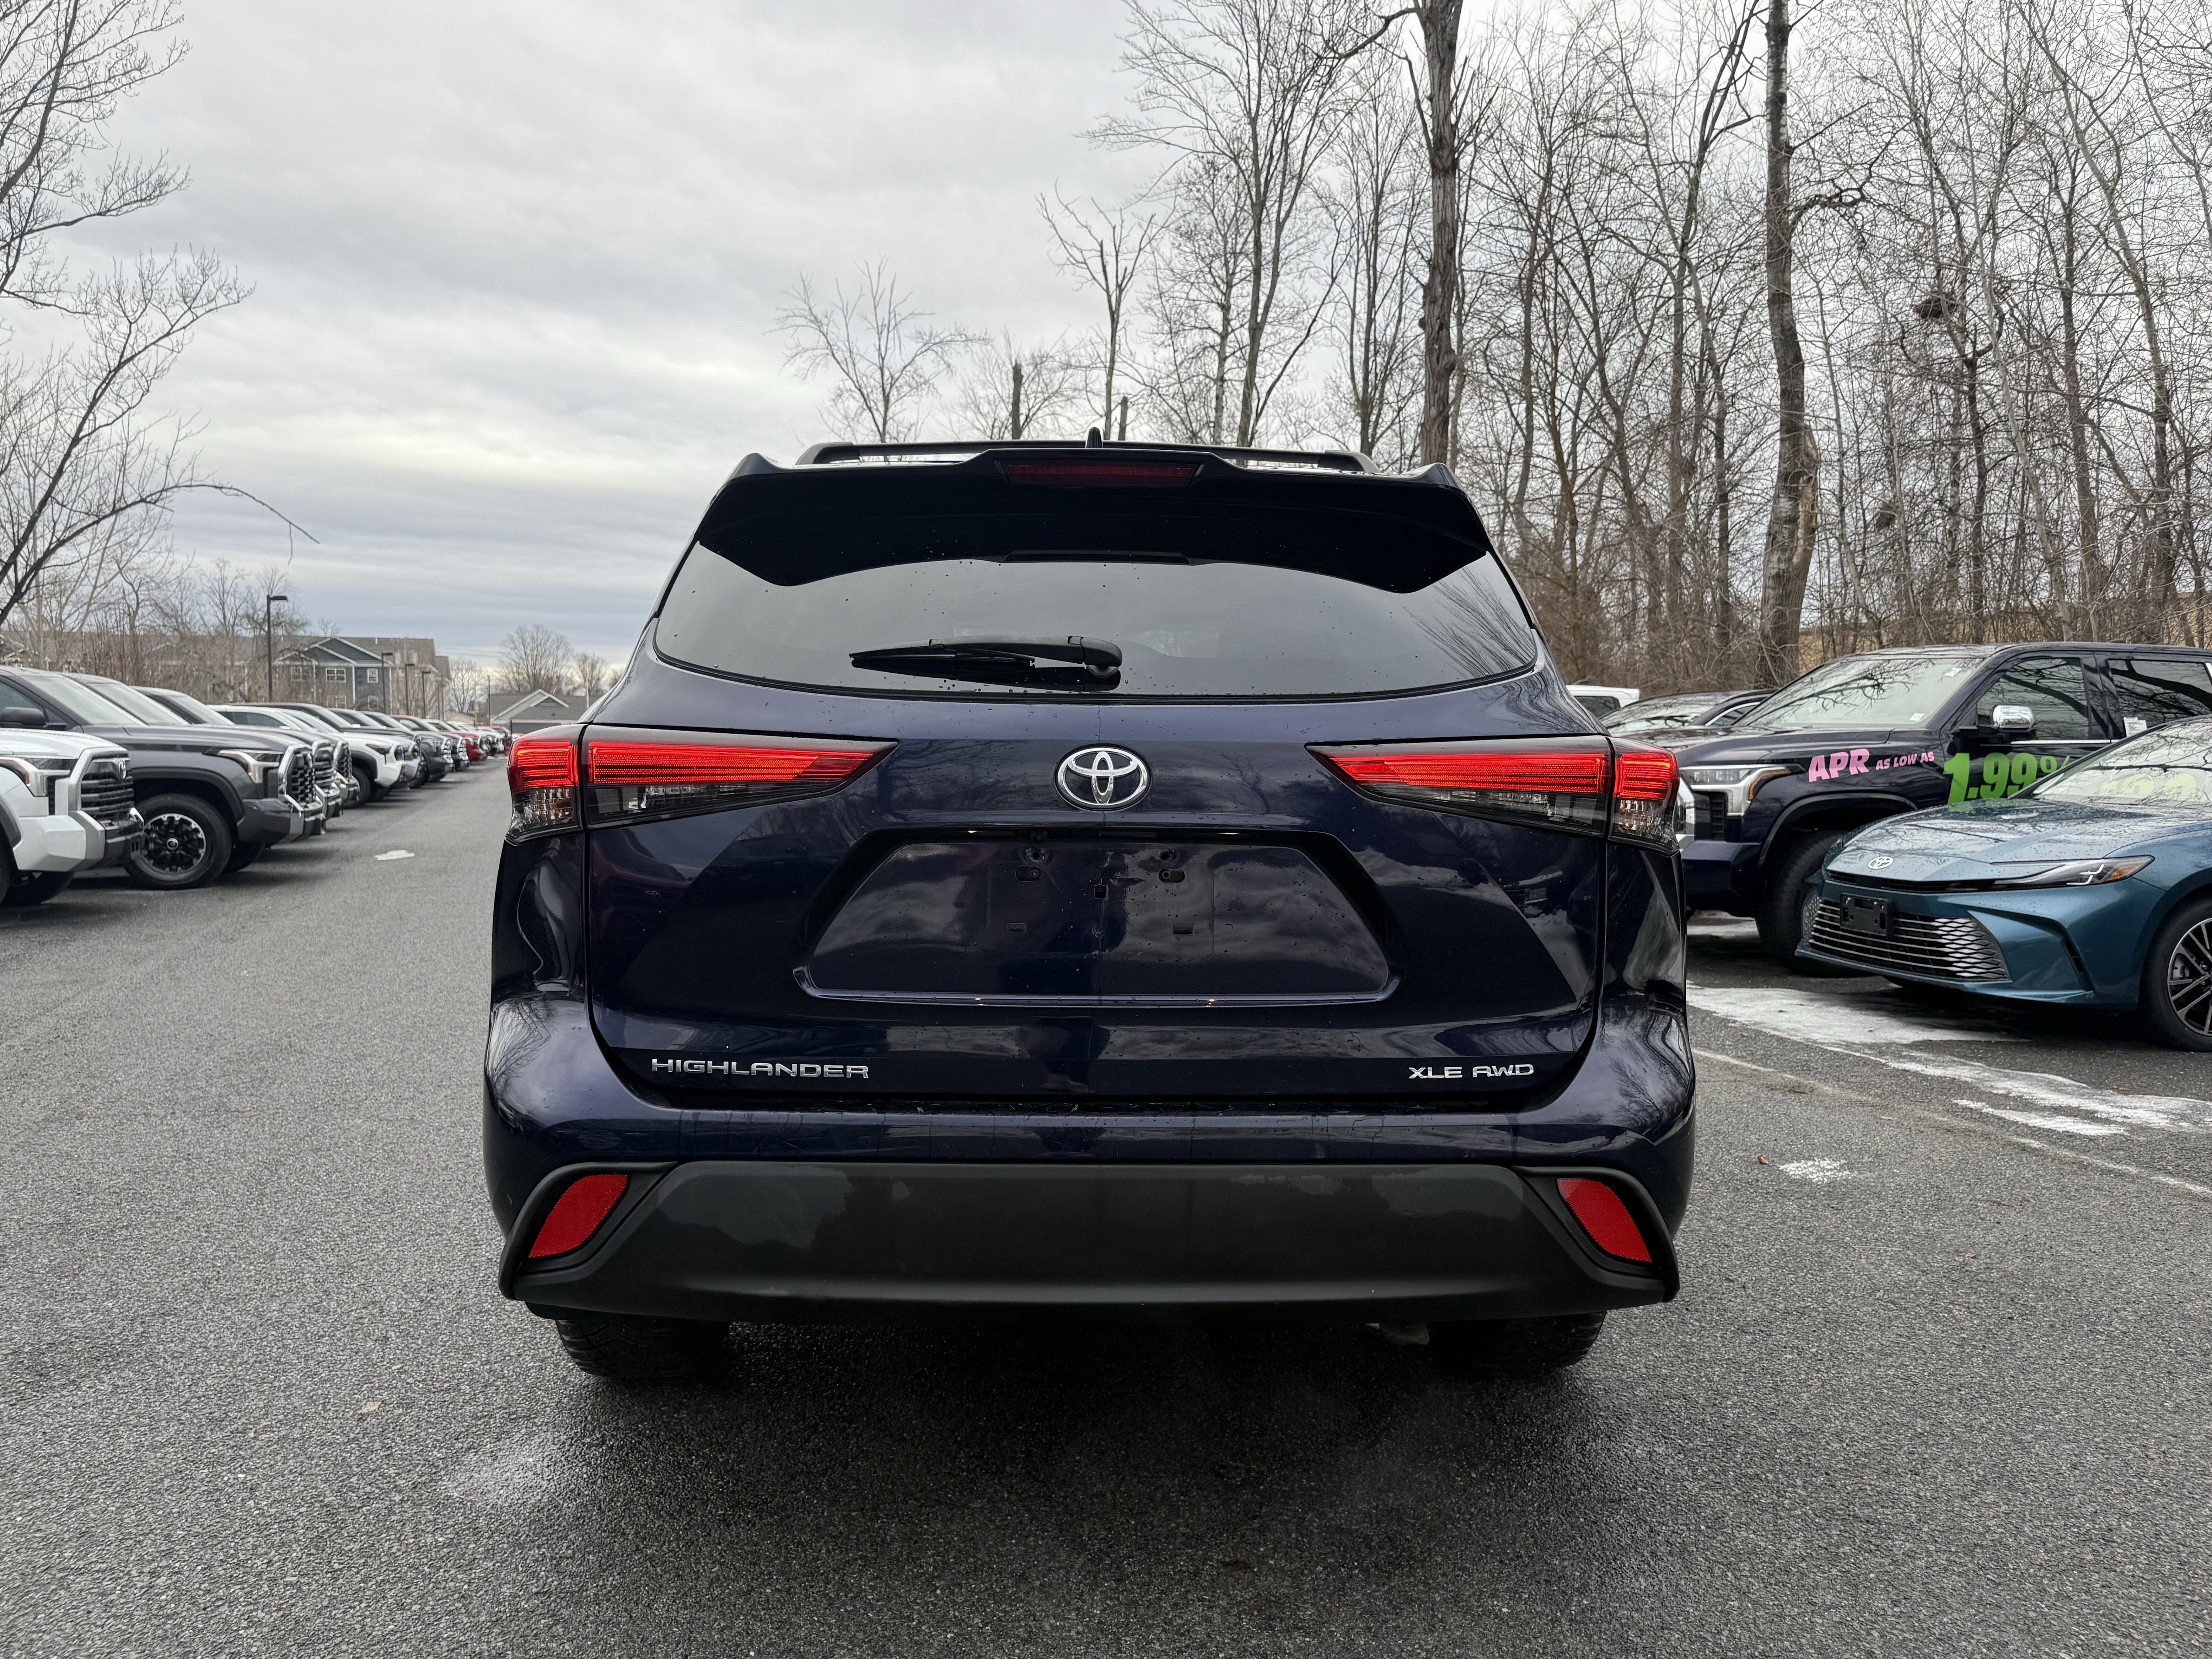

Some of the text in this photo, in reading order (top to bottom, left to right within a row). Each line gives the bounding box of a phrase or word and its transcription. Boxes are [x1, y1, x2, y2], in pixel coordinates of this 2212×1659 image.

[1808, 748, 1870, 782] APR
[1875, 758, 1891, 770] AS
[1893, 754, 1917, 768] LOW
[1920, 751, 1935, 763] AS
[652, 1058, 869, 1079] HIGHLANDER
[1408, 1064, 1534, 1079] XLE AWD
